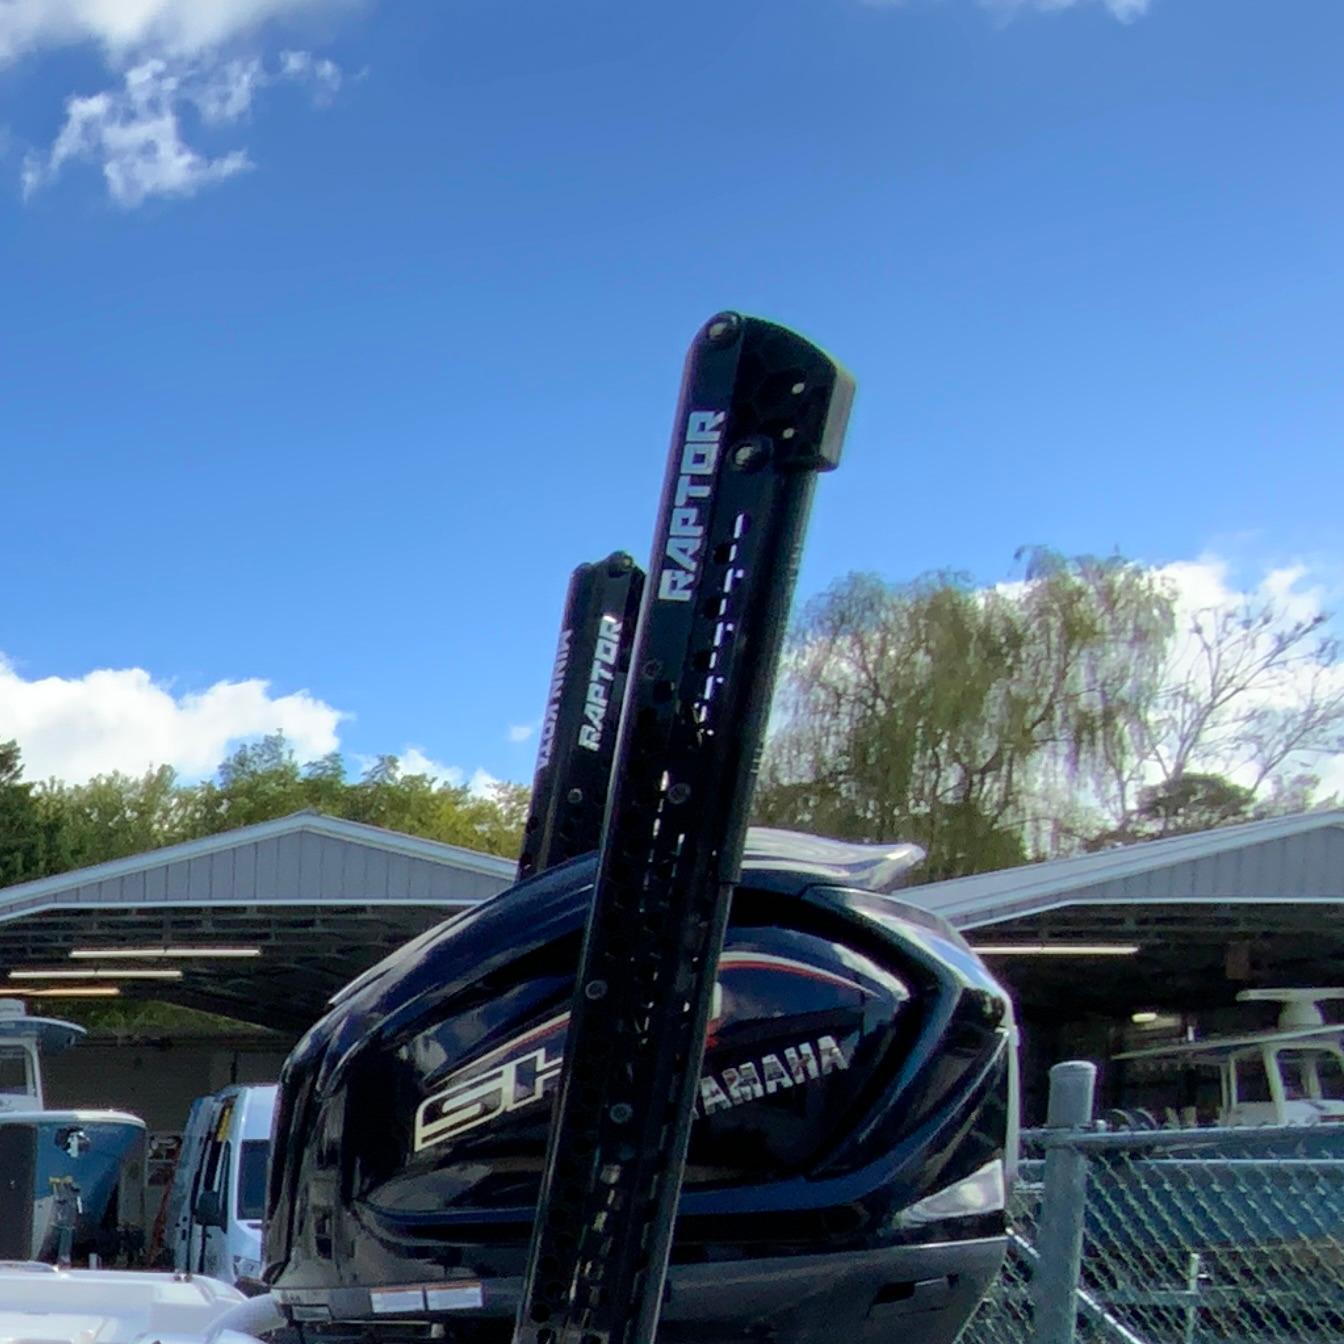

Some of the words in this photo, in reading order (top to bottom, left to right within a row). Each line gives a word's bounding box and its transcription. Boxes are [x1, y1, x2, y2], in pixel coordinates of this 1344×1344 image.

[658, 411, 725, 601] RAPTOR
[578, 615, 623, 751] RAPTOR
[691, 1035, 850, 1121] AMAHA
